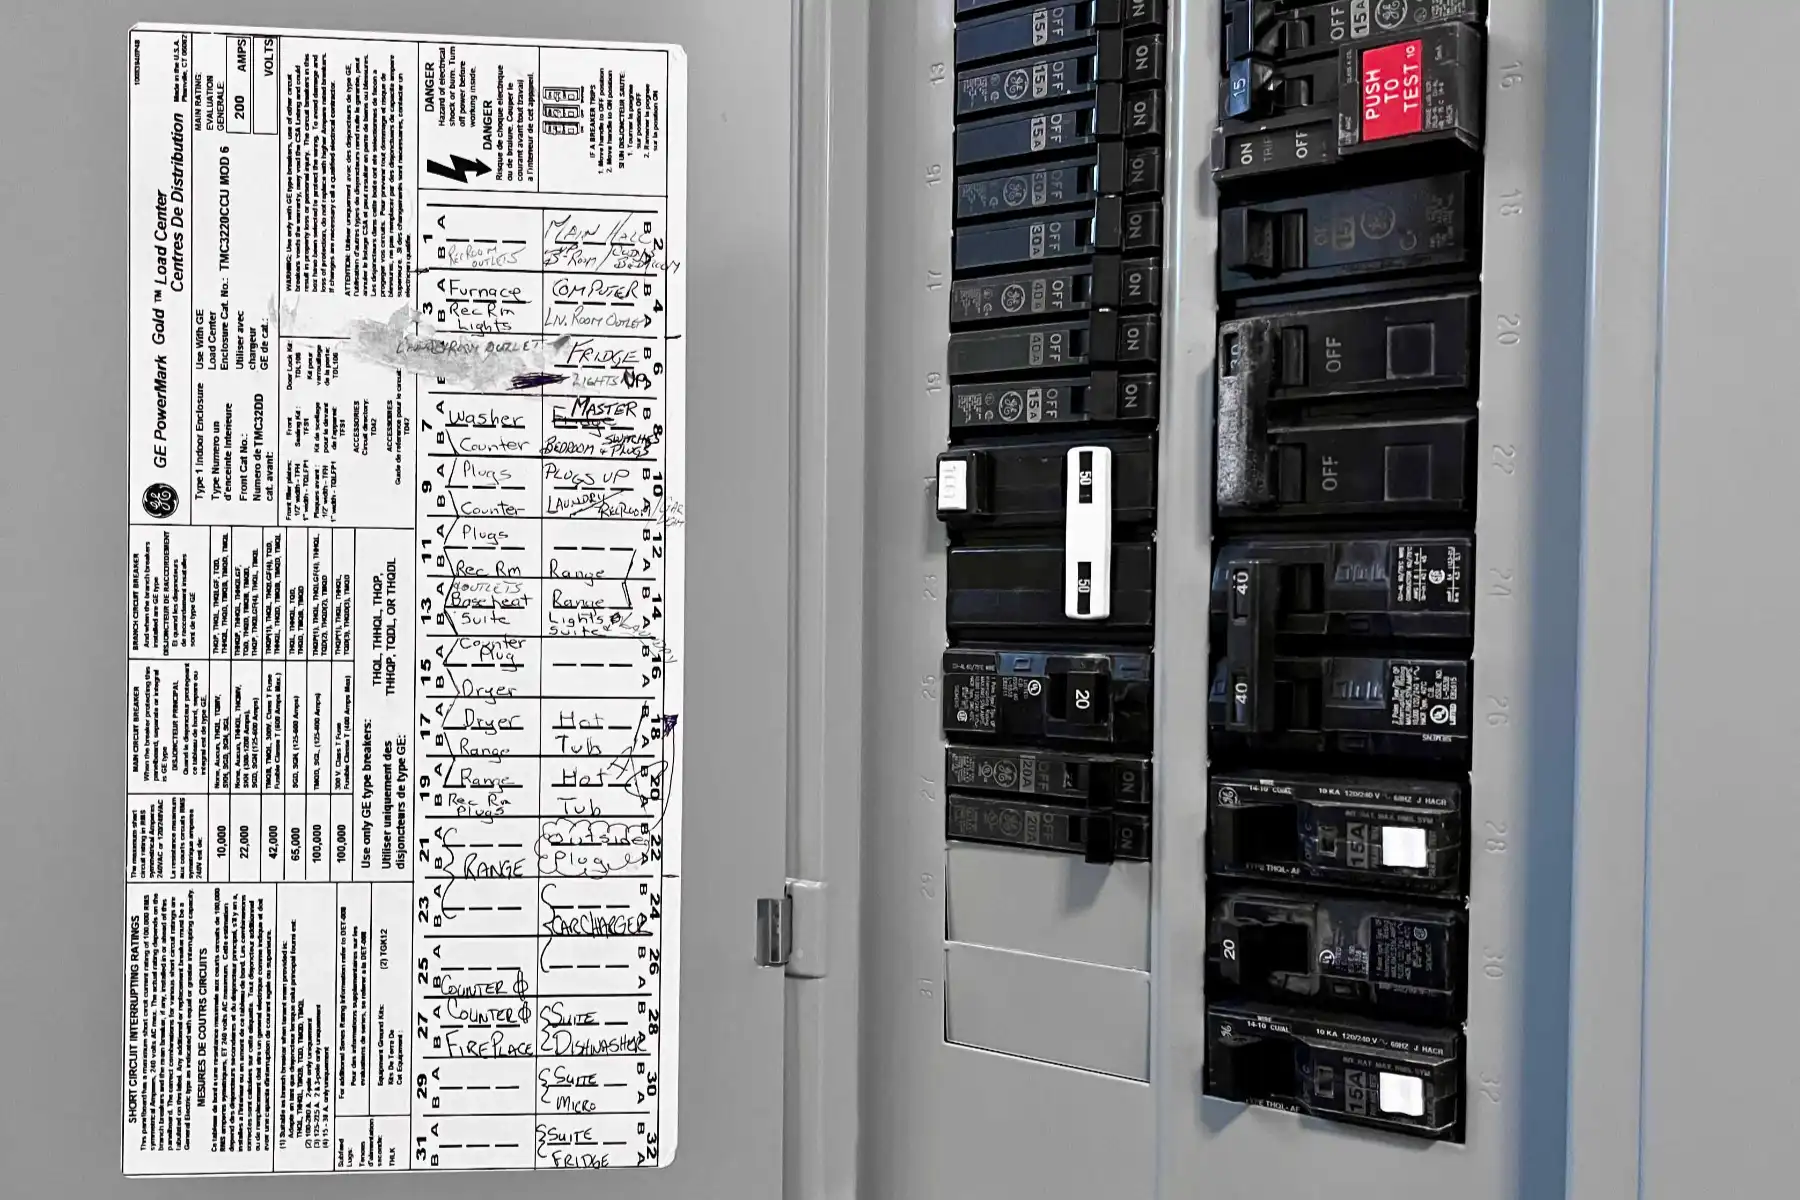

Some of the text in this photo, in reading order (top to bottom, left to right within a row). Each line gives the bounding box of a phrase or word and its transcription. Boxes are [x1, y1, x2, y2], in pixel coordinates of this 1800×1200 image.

[1034, 10, 1046, 43] 15A
[1052, 7, 1064, 37] OFF
[1330, 6, 1345, 40] OFF
[264, 38, 275, 76] VOLTS
[1135, 45, 1149, 71] ON
[234, 38, 246, 120] 200 AMPS
[425, 62, 434, 112] DANGER
[1034, 63, 1045, 95] 15A
[1403, 62, 1419, 112] TEST
[1500, 60, 1523, 89] 16
[438, 87, 445, 96] of
[1232, 78, 1246, 99] 15
[1365, 68, 1381, 120] PUSH
[1384, 78, 1400, 102] TO
[483, 100, 492, 150] DANGER
[1133, 101, 1146, 127] ON
[1050, 114, 1062, 143] OFF
[1240, 142, 1253, 165] ON
[1295, 130, 1309, 159] OFF
[220, 156, 229, 185] MOD
[1132, 158, 1144, 183] ON
[154, 189, 167, 241] Center
[171, 113, 183, 292] Centres De Distribution
[1500, 188, 1523, 217] 18
[219, 188, 229, 271] TMC3220CCU
[422, 234, 434, 244] 1
[1129, 214, 1142, 239] ON
[154, 244, 167, 285] Load
[449, 279, 521, 298] Furnace
[552, 277, 640, 299] COMPUTER
[925, 270, 943, 293] 17
[1051, 279, 1064, 309] OFF
[1128, 273, 1142, 296] ON
[196, 309, 204, 325] GE
[220, 300, 228, 320] Cat.
[422, 301, 434, 315] 3
[152, 308, 165, 345] Gold
[196, 326, 204, 349] With
[458, 319, 512, 336] Lights
[1127, 328, 1140, 351] ON
[1497, 314, 1521, 346] 20
[208, 311, 216, 370] Load Center
[220, 321, 228, 370] Enclosure
[567, 338, 640, 364] FRIDGE
[1050, 333, 1061, 362] OFF
[1325, 336, 1342, 373] OFF
[154, 355, 167, 441] PowerMark
[571, 397, 638, 417] MASTER
[1028, 389, 1040, 420] 15A
[1046, 388, 1058, 419] OFF
[1124, 384, 1138, 408] ON
[254, 394, 263, 447] TMC32DD
[421, 418, 434, 432] 7
[449, 410, 526, 426] Washer
[154, 444, 166, 468] GE
[195, 433, 203, 466] Indoor
[459, 437, 530, 451] Counter
[463, 461, 512, 485] Plugs
[544, 463, 630, 485] PLUGS UP
[1079, 470, 1092, 486] 50
[1322, 456, 1338, 491] OFF
[195, 475, 205, 500] Type
[421, 481, 432, 493] 9
[461, 500, 526, 515] Counter
[462, 525, 509, 545] Plugs
[421, 538, 432, 564] 11
[456, 560, 521, 577] Rec Rm
[550, 558, 605, 587] Range
[1077, 578, 1090, 593] 50
[1237, 571, 1248, 595] 40
[420, 597, 432, 625] 13
[553, 589, 605, 616] Range
[373, 573, 384, 687] THQL, THHQL, THQP,
[386, 557, 397, 696] THHQP, TQDL, OR THQDL
[462, 613, 511, 624] Suite
[420, 657, 431, 686] 15
[462, 679, 517, 704] Dryer
[1076, 689, 1090, 710] 20
[1235, 682, 1247, 705] 40
[419, 712, 431, 740] 17
[465, 709, 520, 735] Dryer
[559, 711, 605, 728] Hot
[555, 735, 602, 755] Tub
[419, 774, 430, 802] 19
[460, 768, 516, 793] Range
[563, 769, 608, 785] Hot
[1122, 771, 1134, 793] ON
[361, 719, 373, 868] Use only GE type breakers:
[557, 797, 602, 816] Tub
[217, 825, 227, 858] 10,000
[240, 825, 250, 859] 22,000
[269, 825, 279, 859] 42,000
[291, 827, 301, 861] 65,000
[312, 824, 323, 863] 100,000
[337, 824, 347, 863] 100,000
[418, 837, 430, 863] 21
[464, 853, 526, 880] RANGE
[1224, 939, 1235, 959] 20
[417, 957, 428, 985] 25
[441, 975, 508, 996] COUNTER
[128, 915, 139, 1123] SHORT CIRCUIT INTERRUPTING RATINGS
[447, 997, 518, 1023] COUNTER
[549, 1002, 598, 1027] SUITE
[197, 948, 207, 1107] MESURES DE COUTRS CIRCUITS
[1316, 1028, 1325, 1036] 10
[1326, 1029, 1338, 1038] KA
[446, 1030, 534, 1058] FIREPLACE
[553, 1030, 647, 1055] DISHWASHER
[554, 1066, 597, 1085] SUITE
[556, 1096, 596, 1112] MICRO
[547, 1128, 593, 1142] SUITE
[552, 1152, 610, 1168] FRIDGE
